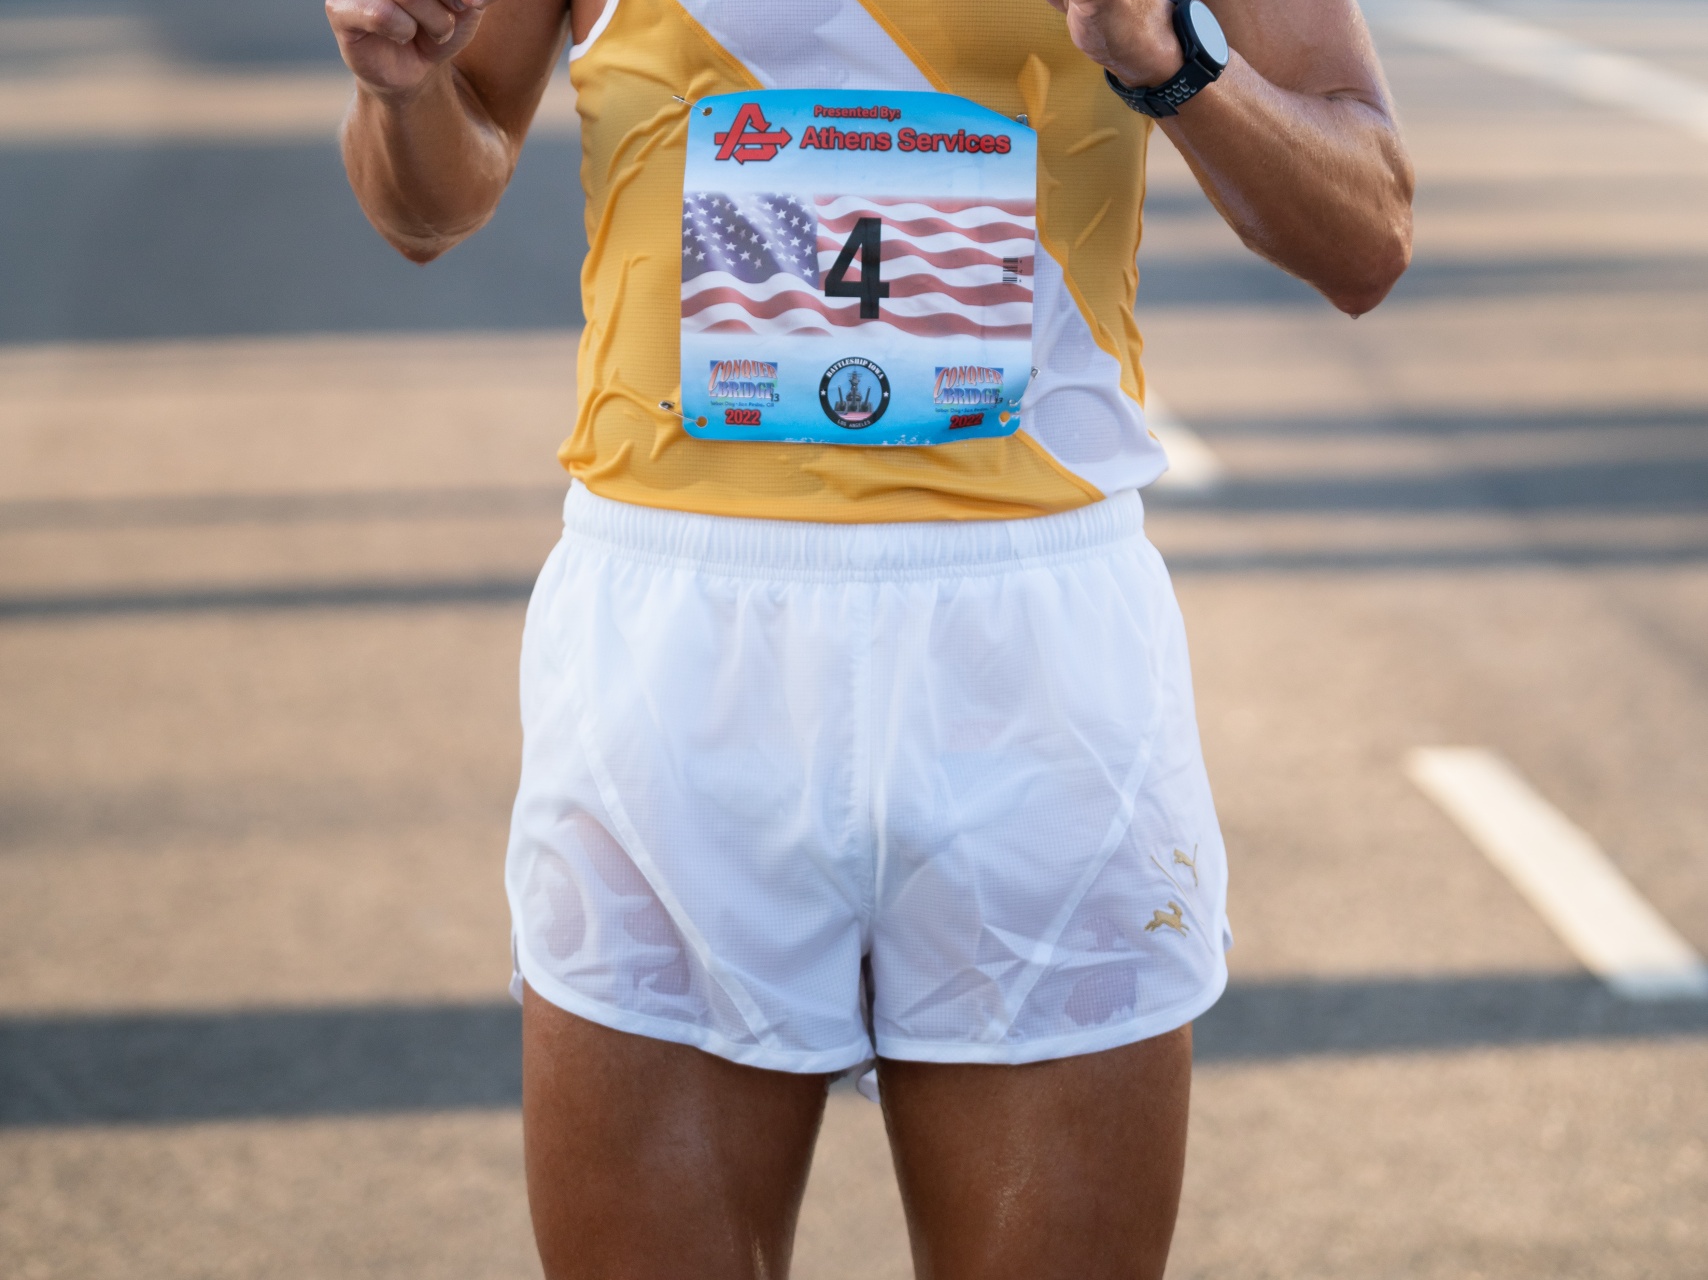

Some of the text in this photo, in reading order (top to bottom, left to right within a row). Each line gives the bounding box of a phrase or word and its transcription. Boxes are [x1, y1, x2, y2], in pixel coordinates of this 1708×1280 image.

[813, 104, 901, 122] Presented By:
[799, 125, 1011, 155] Athens Services
[824, 217, 890, 319] 4
[826, 358, 885, 380] BATTLESHIP IOWA
[724, 408, 762, 427] 2022
